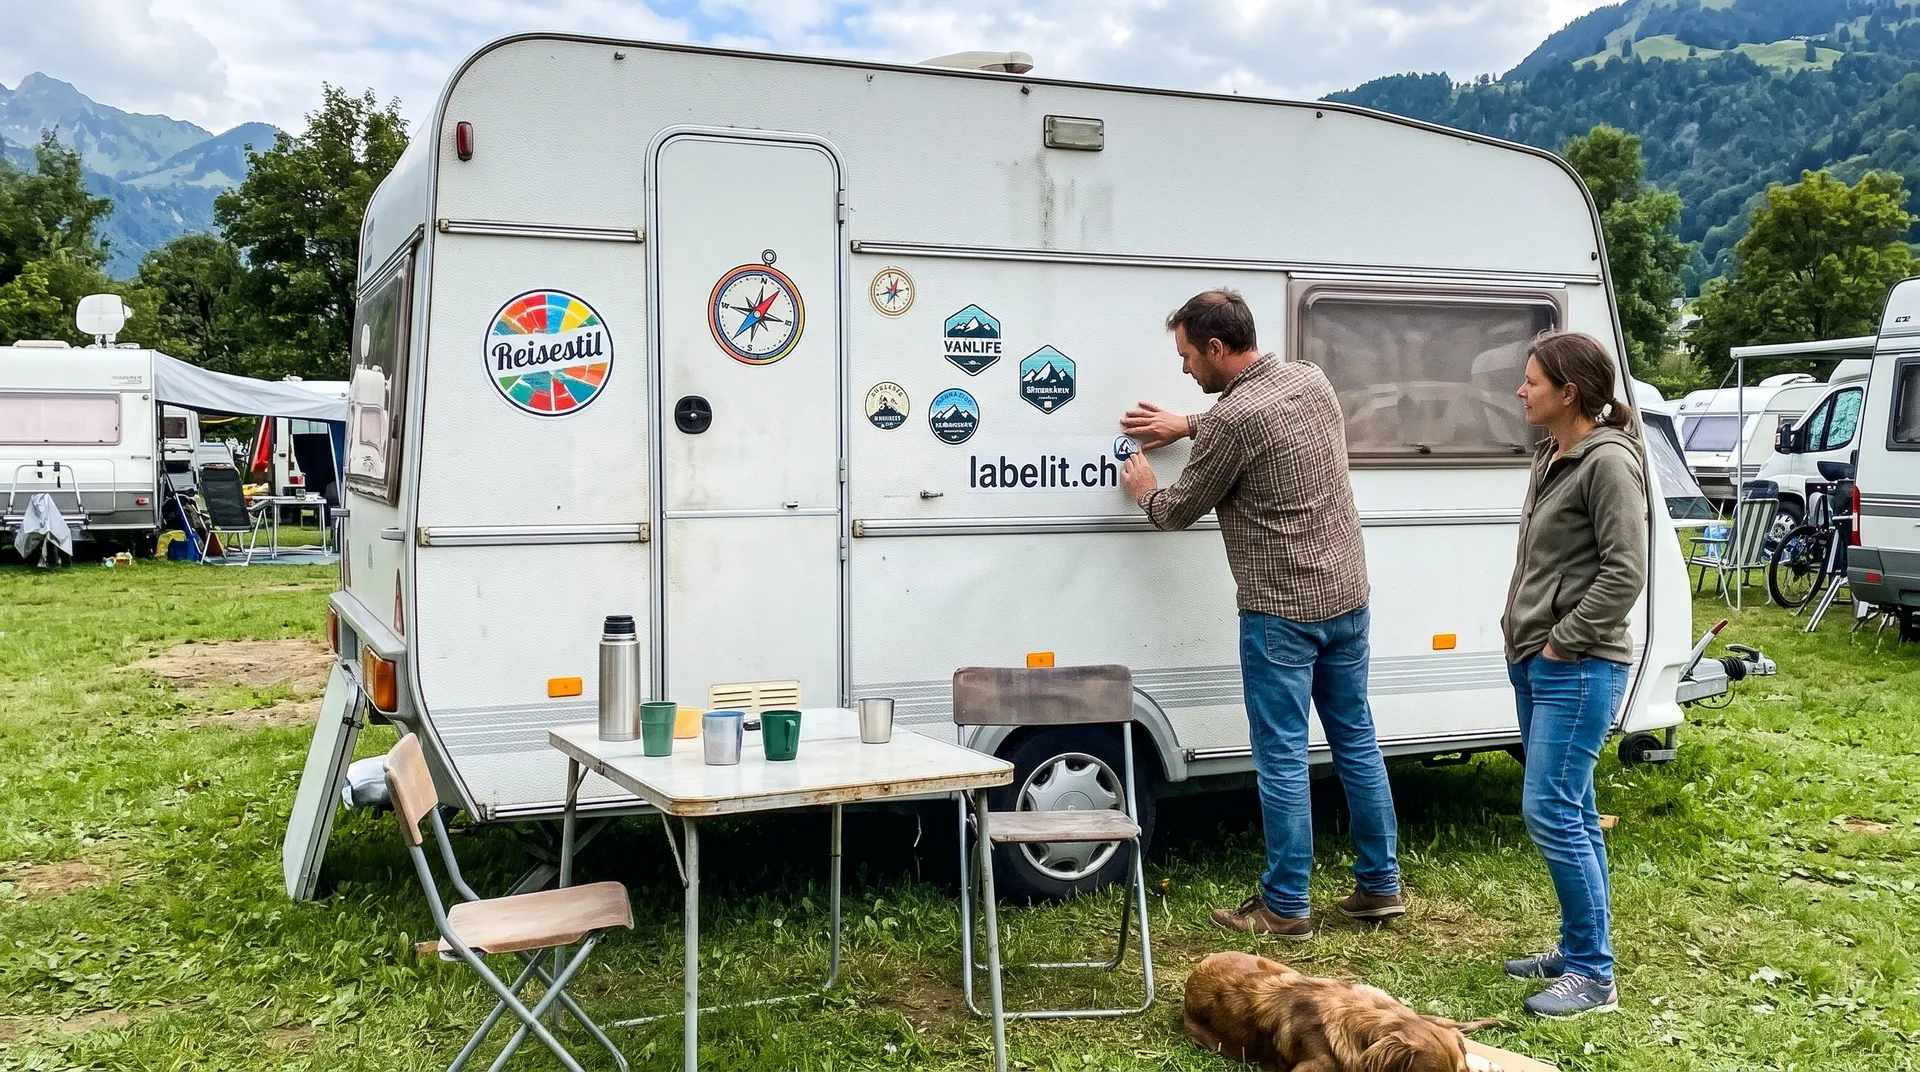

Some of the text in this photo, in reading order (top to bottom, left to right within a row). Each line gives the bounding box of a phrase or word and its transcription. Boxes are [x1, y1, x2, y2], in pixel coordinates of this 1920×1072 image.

[760, 277, 768, 285] N
[492, 331, 603, 371] Reisestil
[747, 344, 753, 352] S
[944, 340, 1002, 354] VANLIFE
[970, 455, 1117, 488] labelit.ch
